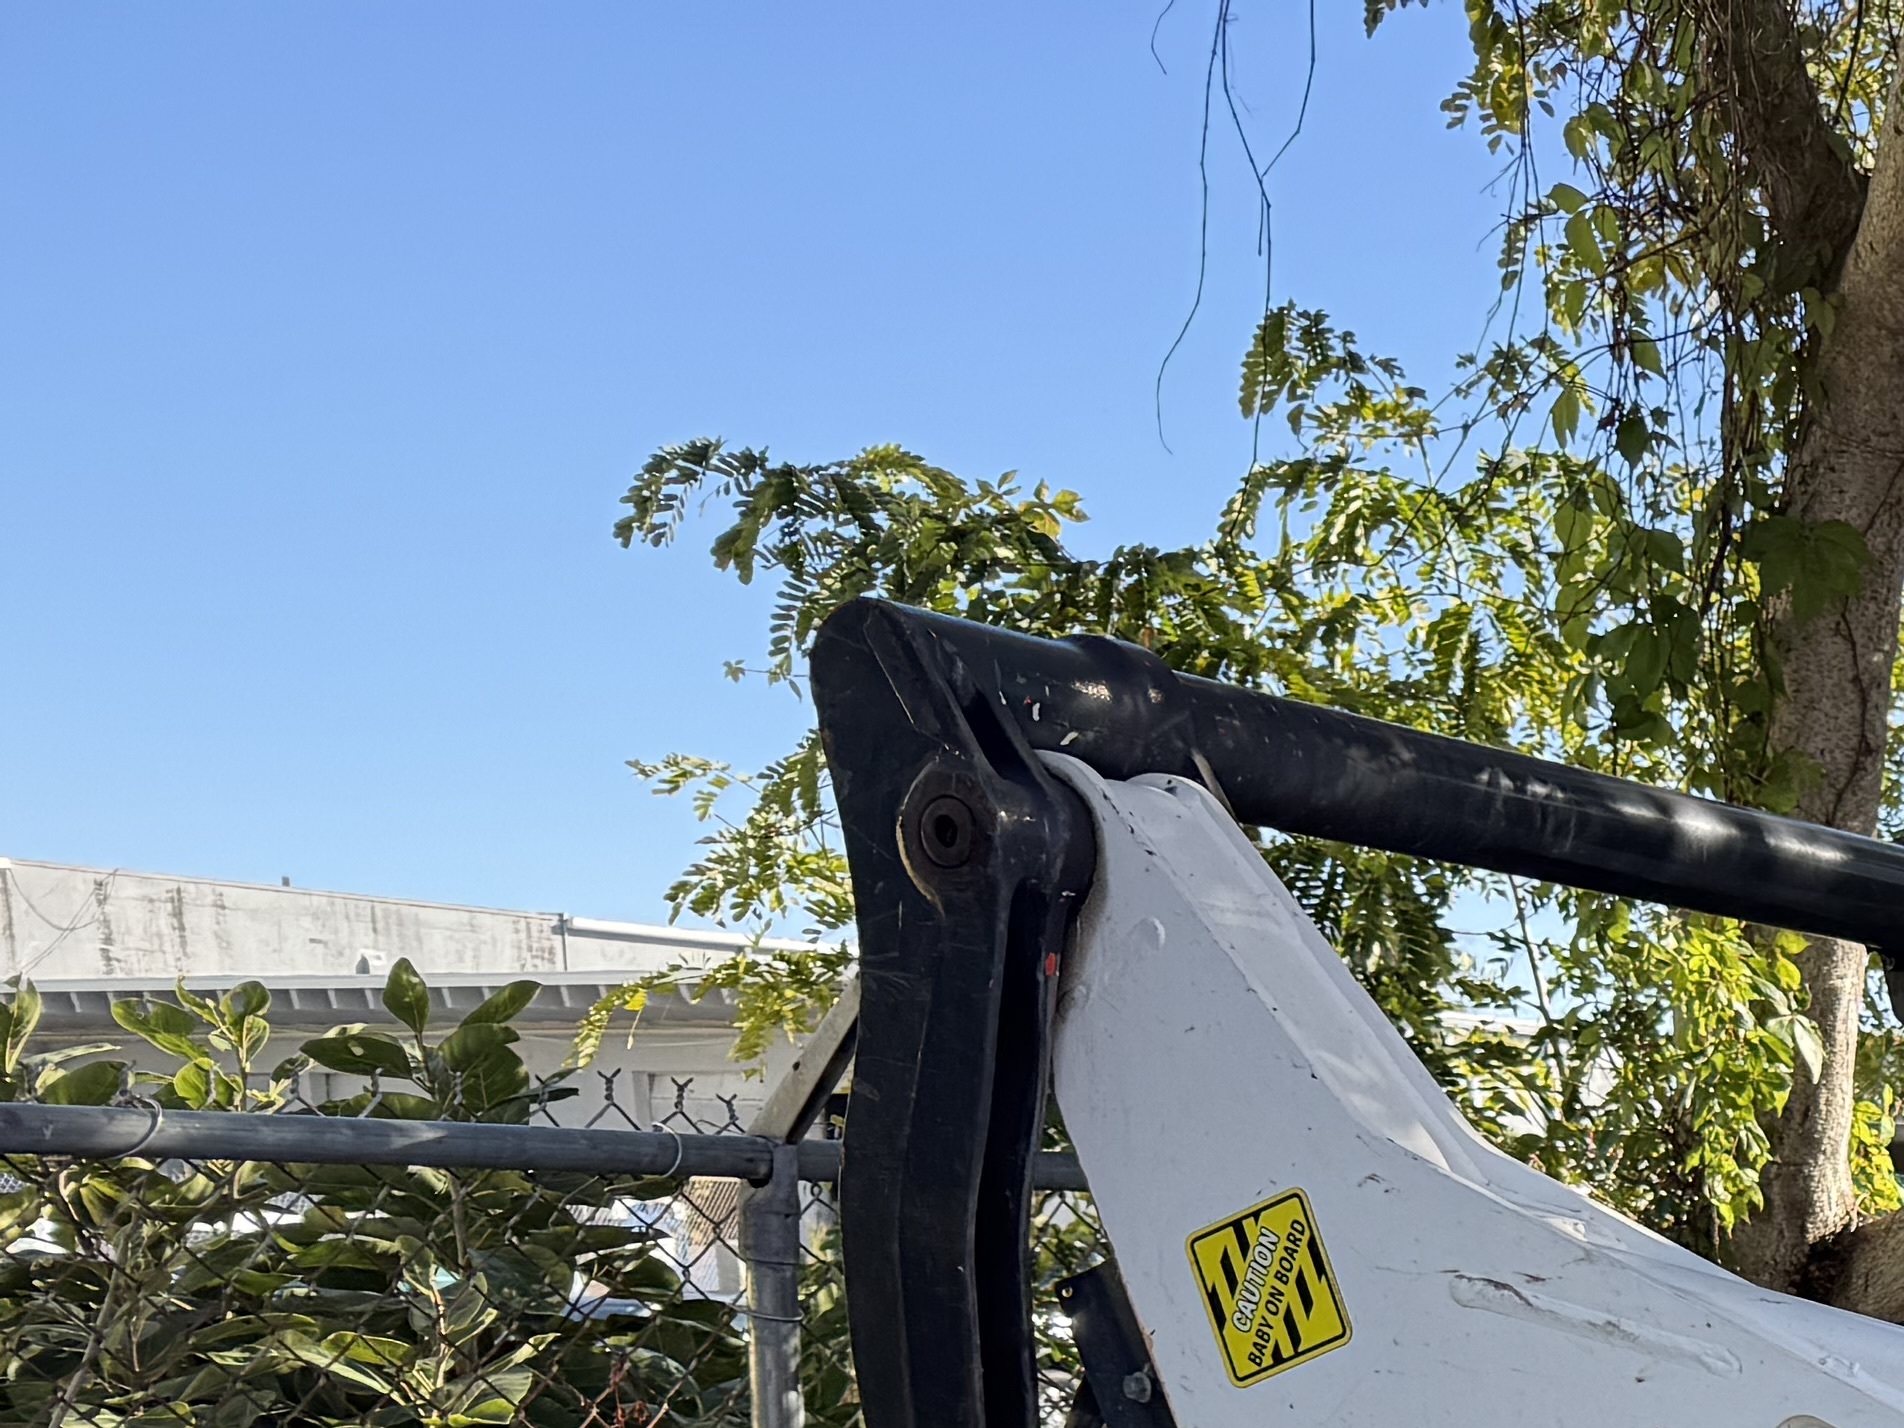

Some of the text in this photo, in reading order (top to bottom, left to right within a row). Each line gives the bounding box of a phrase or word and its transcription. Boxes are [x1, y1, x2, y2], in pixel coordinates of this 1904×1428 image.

[1231, 1226, 1281, 1333] CAUTION
[1247, 1219, 1306, 1368] BABY ON BOARD
